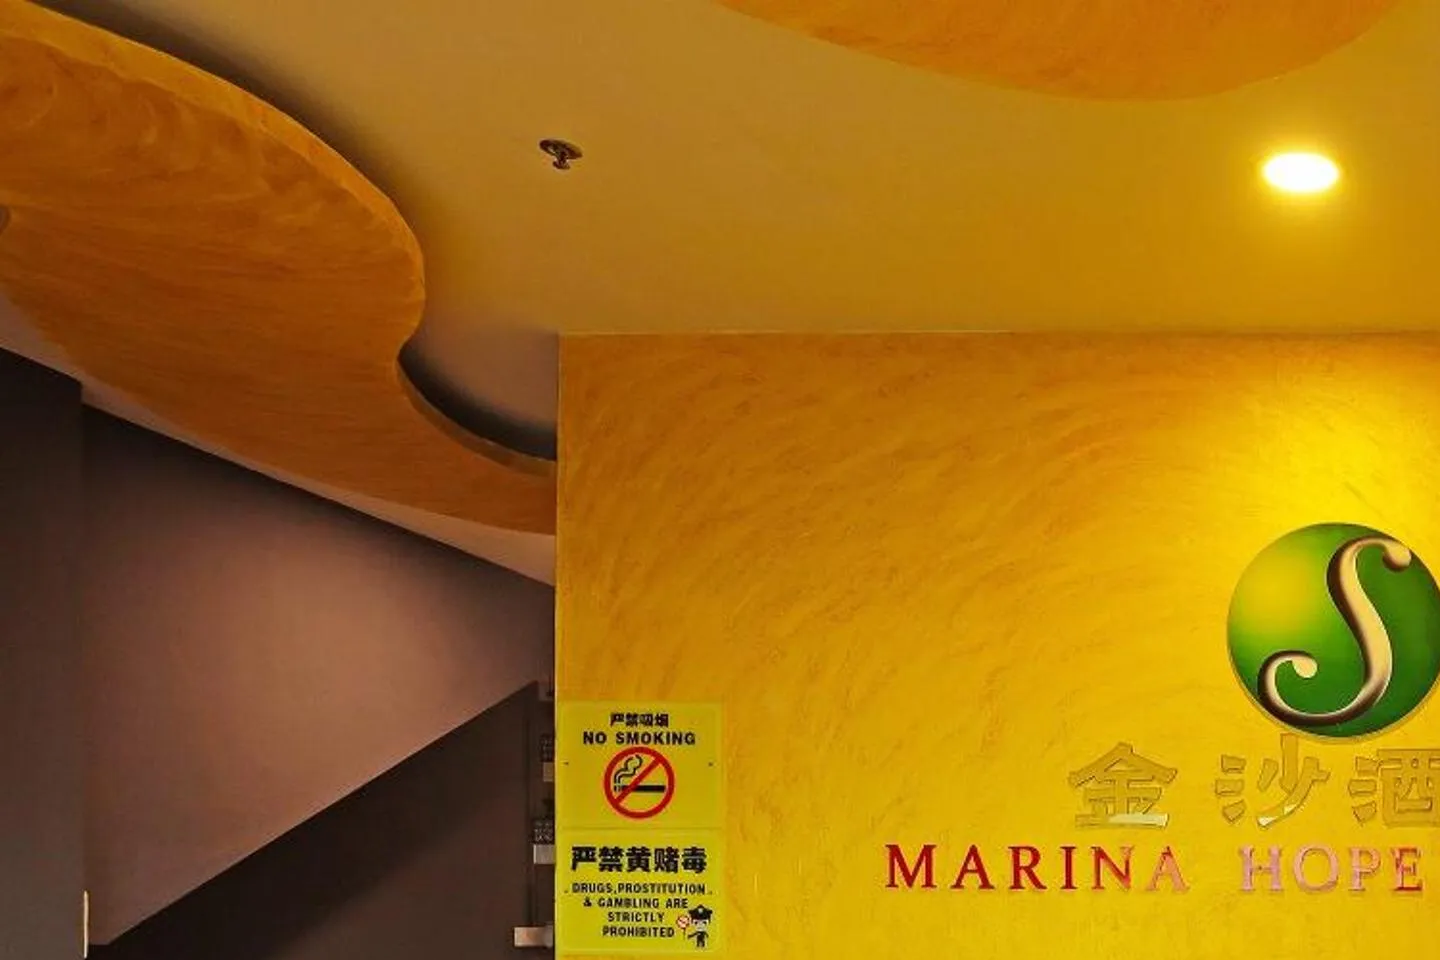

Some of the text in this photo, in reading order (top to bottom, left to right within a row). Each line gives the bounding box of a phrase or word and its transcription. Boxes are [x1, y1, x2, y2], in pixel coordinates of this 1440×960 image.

[583, 731, 696, 745] NO SMOKING
[571, 846, 707, 874] 严禁黄赌毒
[885, 844, 1190, 893] MARINA
[1240, 845, 1424, 893] HOPE
[583, 896, 688, 909] & GAMBLING ARE
[608, 911, 665, 922] STRICTLY
[602, 926, 675, 938] PROHIBITED
